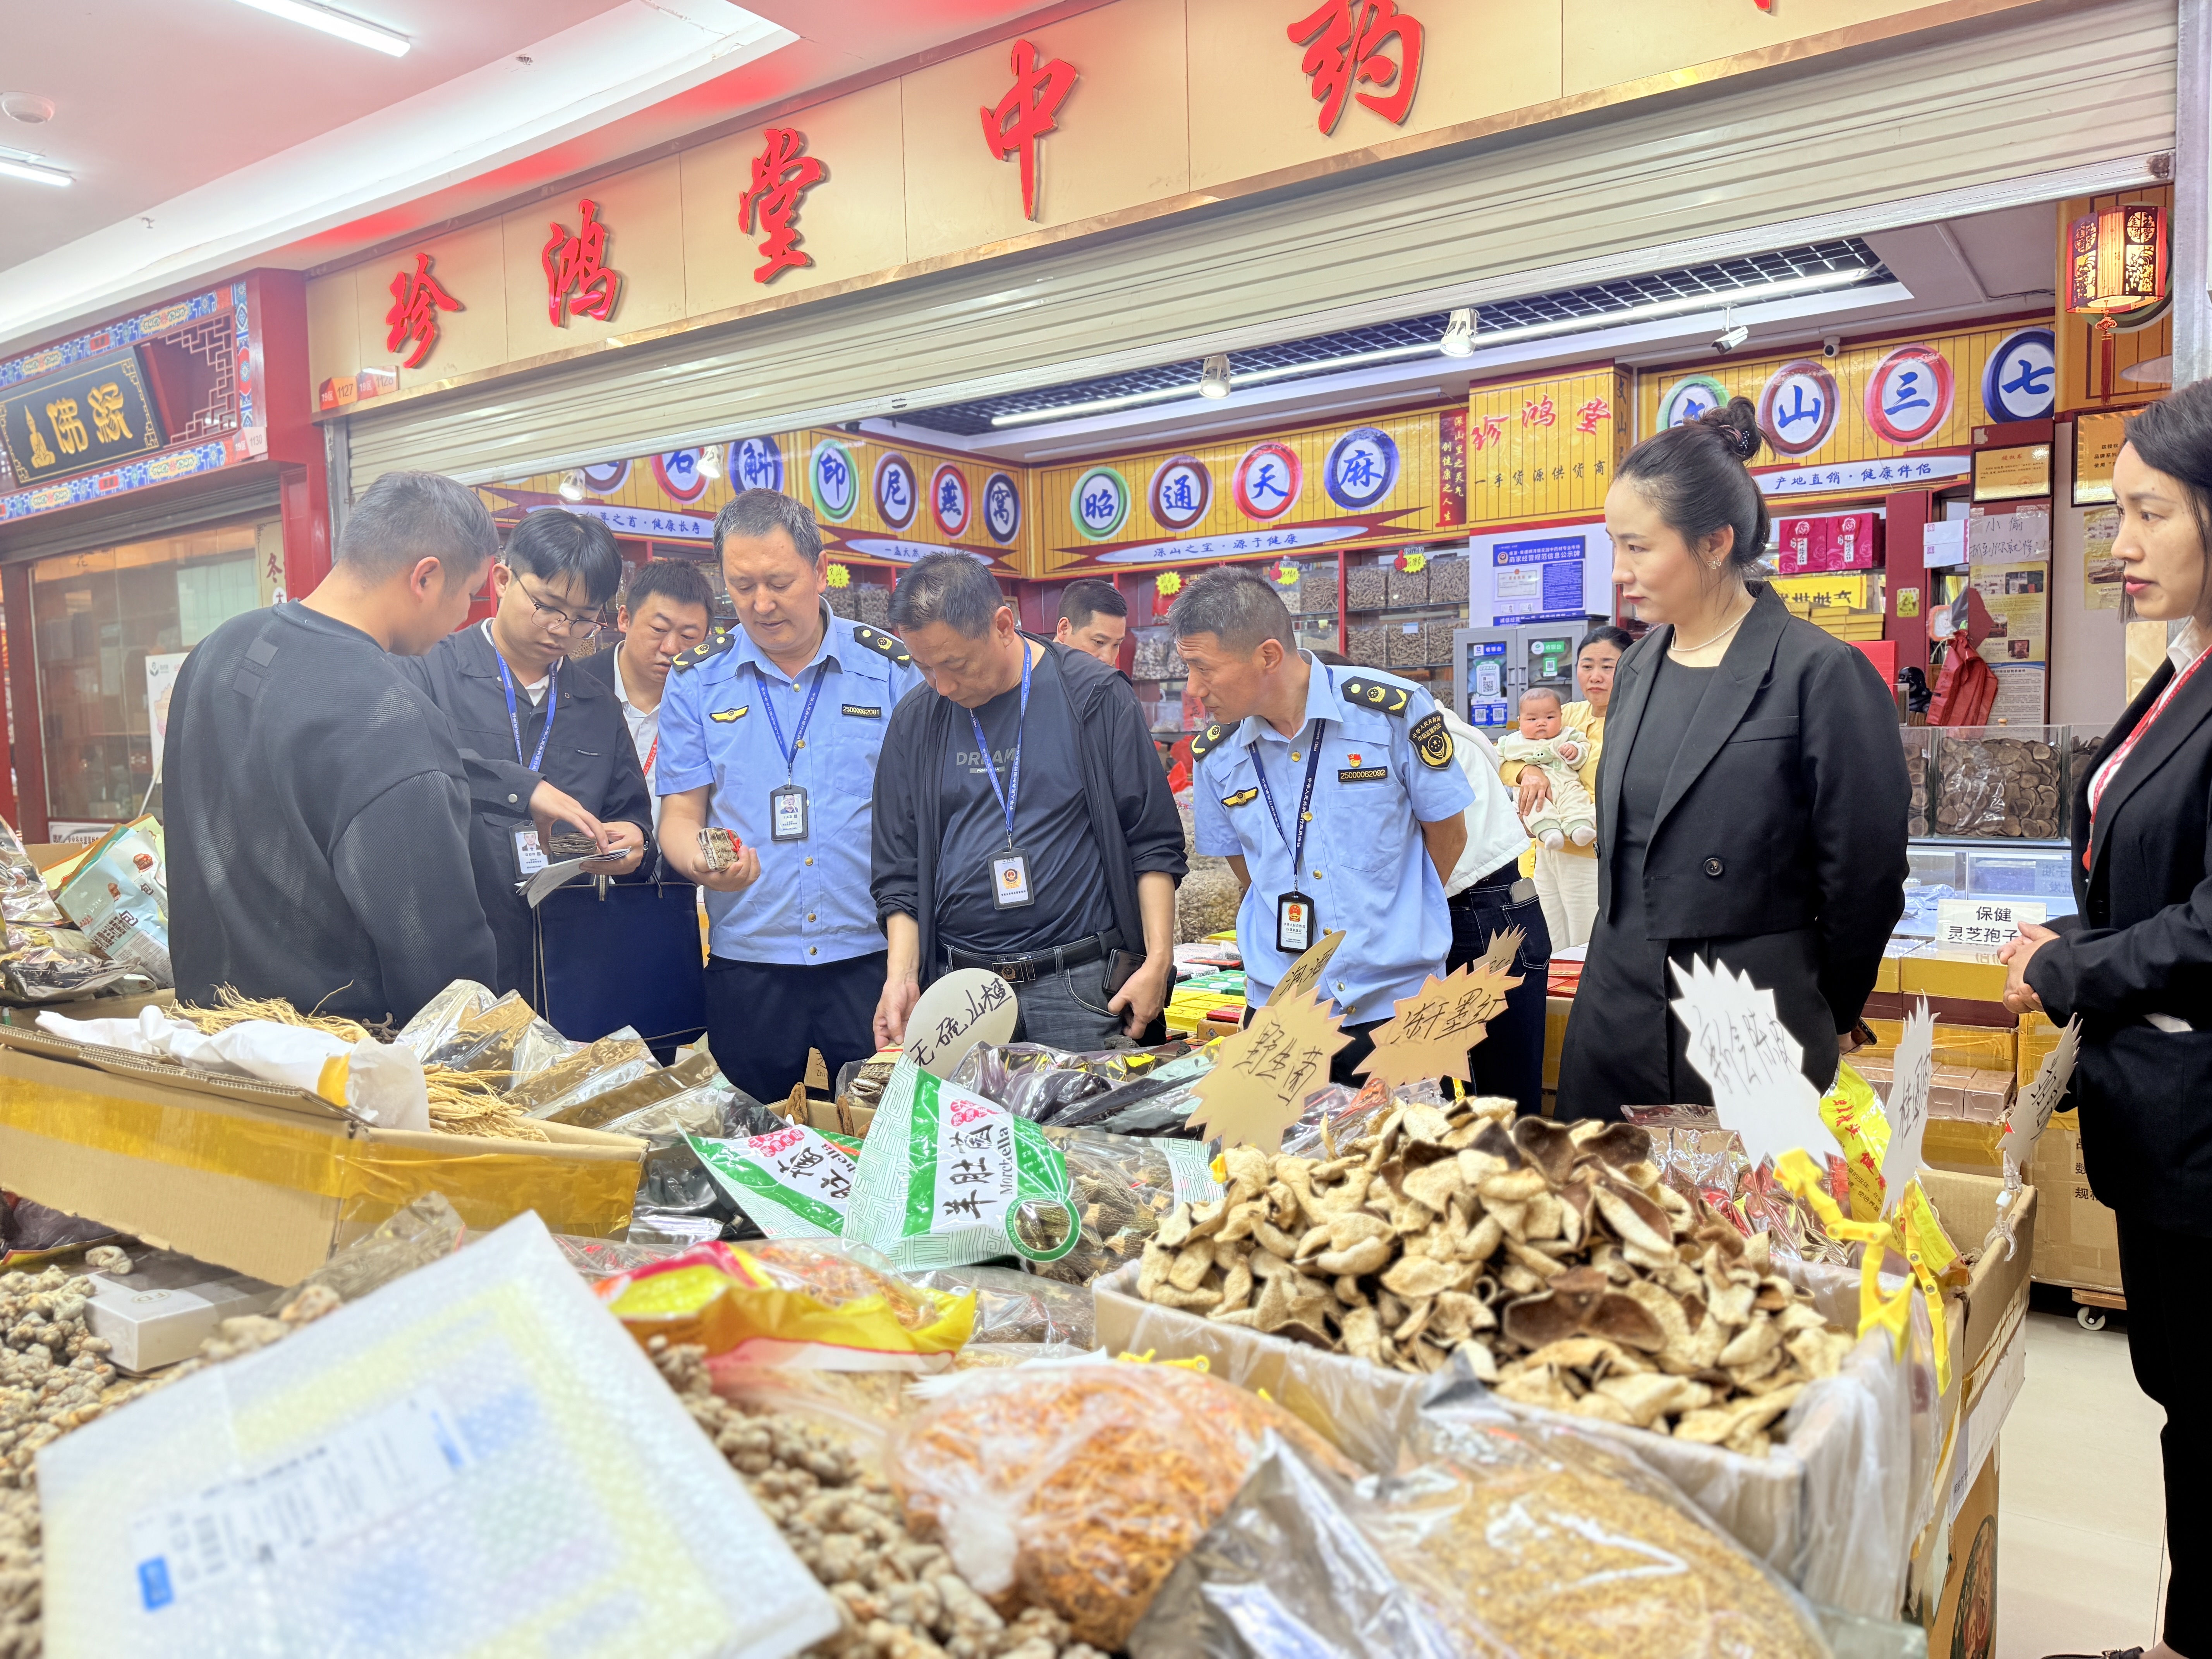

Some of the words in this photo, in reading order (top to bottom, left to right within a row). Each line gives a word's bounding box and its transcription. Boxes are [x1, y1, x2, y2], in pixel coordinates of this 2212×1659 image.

[321, 391, 334, 402] 19区
[337, 383, 353, 398] 1127
[359, 380, 372, 392] 19区
[376, 376, 394, 388] 1128
[1470, 394, 1611, 451] 珍鸿堂
[235, 440, 246, 452] 19区
[249, 434, 262, 447] 1130
[1085, 449, 1383, 520] 昭通天麻
[1441, 441, 1453, 522] 创健康之人生
[1474, 460, 1605, 488] 一手货源供货商
[1774, 462, 1932, 490] 产地直销·健康伴侣
[819, 453, 1010, 526] 印尼燕窝
[588, 511, 700, 534] 草之首·健康长寿
[1154, 533, 1298, 558] 深山之宝·源于健康
[267, 553, 287, 583] 冬
[842, 705, 880, 716] 25000062081
[1412, 716, 1441, 739] 中华人民共和国
[956, 747, 1017, 766] DRAM
[1340, 769, 1386, 780] 25000062092
[1975, 906, 2012, 922] 保健
[1949, 926, 2018, 943] 灵芝孢子
[1233, 1020, 1323, 1106] 野生菌
[821, 1143, 857, 1173] hella
[997, 1126, 1013, 1195] Morchella
[2075, 1163, 2087, 1175] 数
